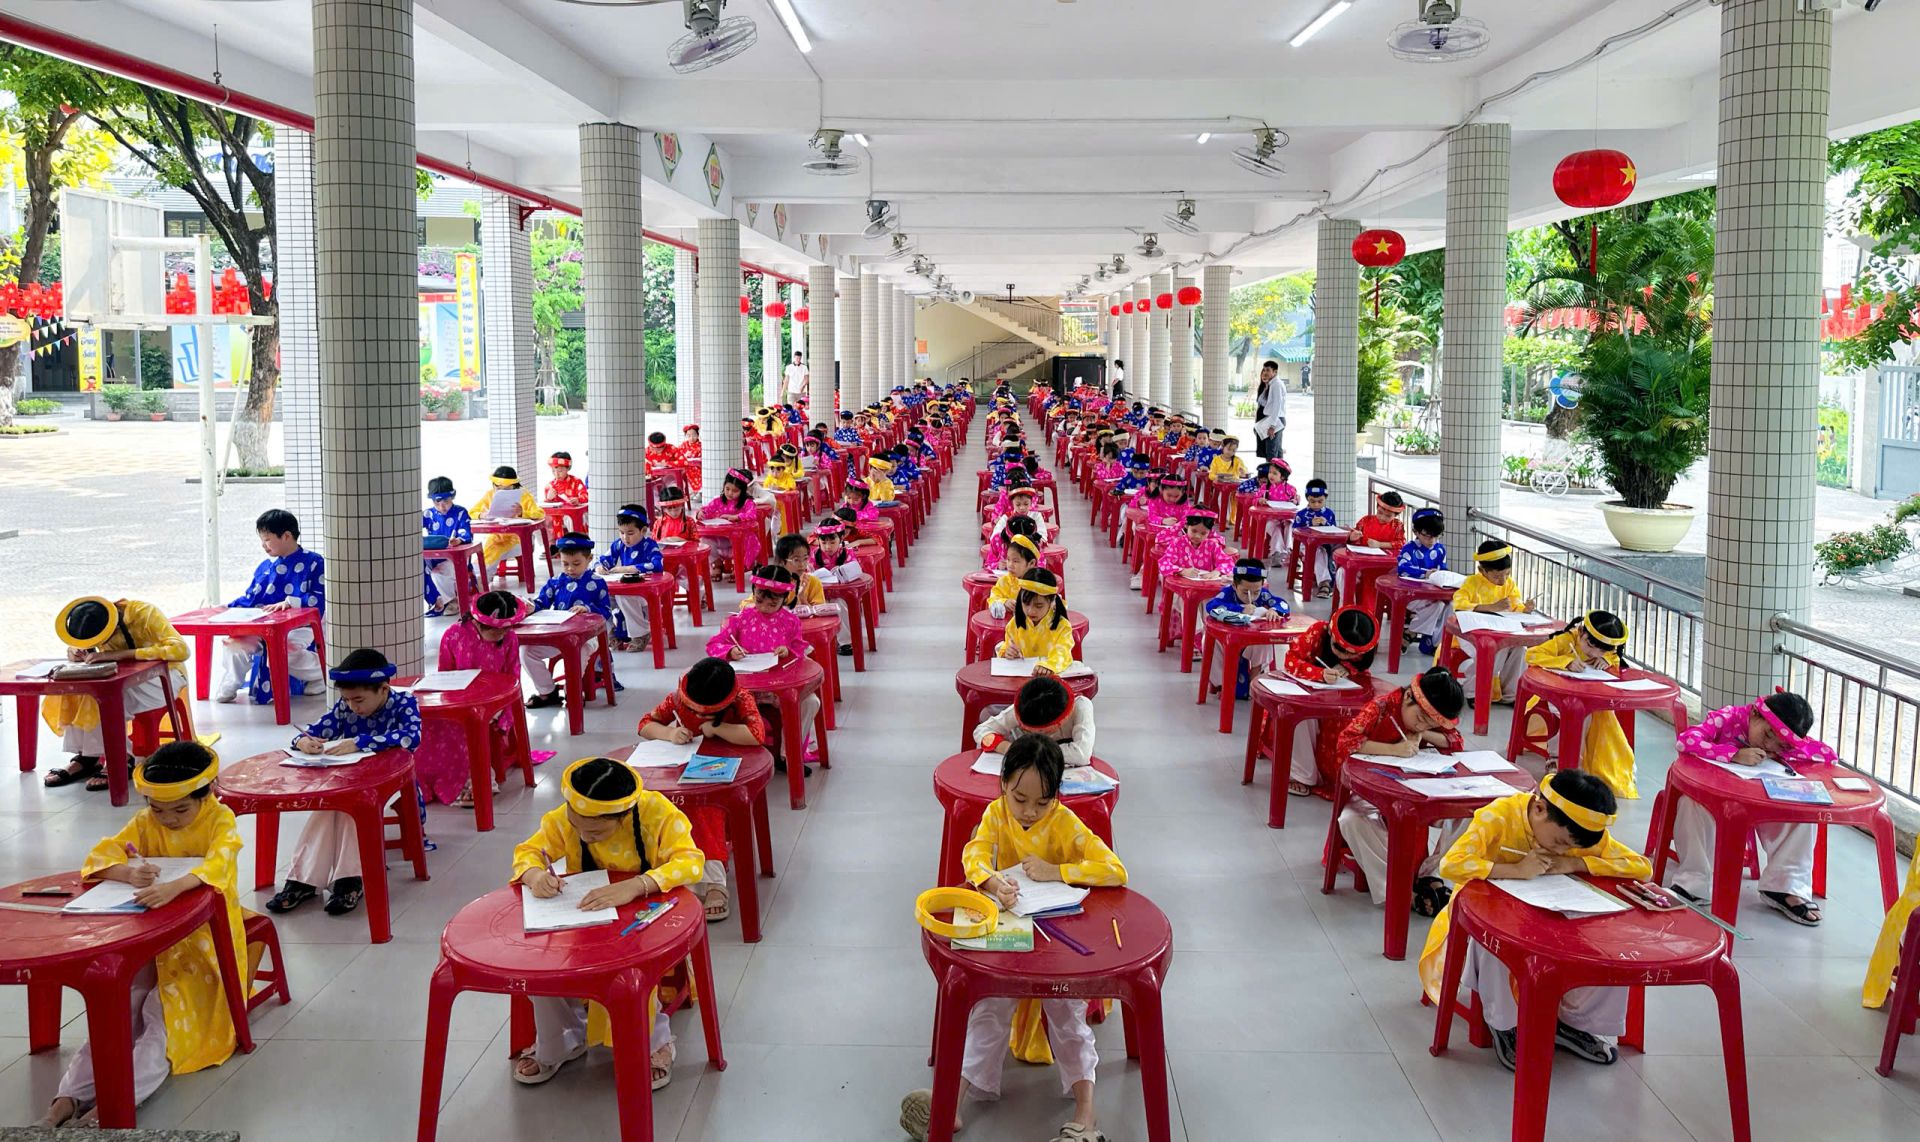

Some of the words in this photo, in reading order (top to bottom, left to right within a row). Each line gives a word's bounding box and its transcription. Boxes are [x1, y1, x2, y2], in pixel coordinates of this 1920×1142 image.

[671, 795, 685, 806] 1/3
[1817, 811, 1833, 822] 1/3
[1481, 930, 1501, 954] 1/7
[1640, 968, 1672, 983] 1/7
[1051, 983, 1069, 993] 4/6
